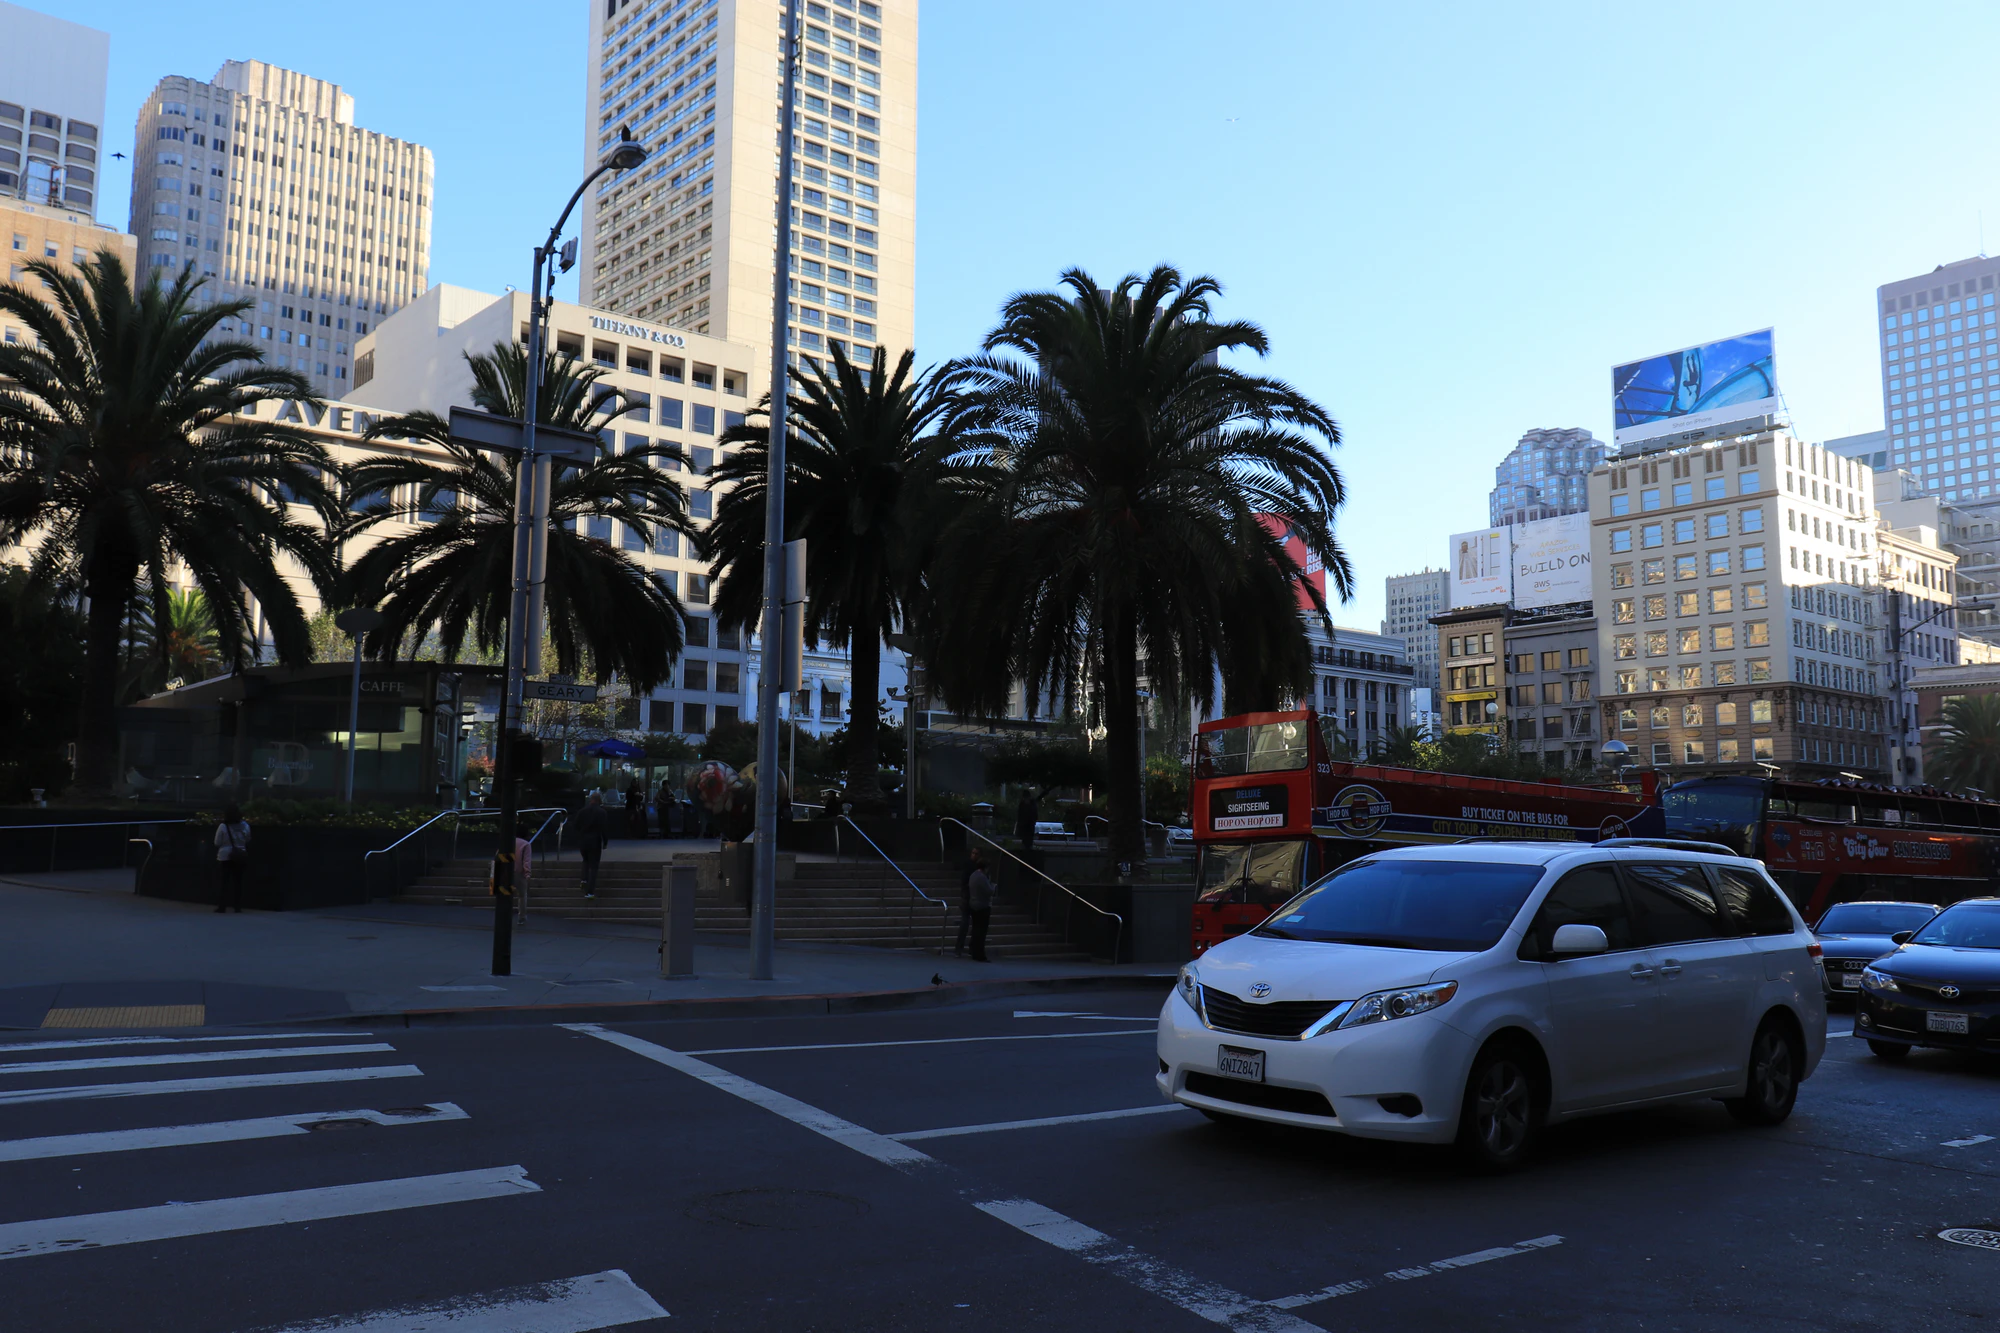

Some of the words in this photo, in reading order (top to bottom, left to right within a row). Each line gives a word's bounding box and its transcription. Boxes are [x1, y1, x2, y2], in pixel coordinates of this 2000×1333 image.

[592, 315, 651, 340] TIFFANY
[1672, 420, 1685, 429] Shot
[1694, 416, 1712, 425] iPhone
[1521, 557, 1565, 577] BUILD
[1569, 552, 1590, 567] ON
[1533, 580, 1551, 588] aws
[537, 685, 585, 698] GEARY
[1317, 763, 1331, 774] 323
[1236, 788, 1262, 799] DELUXE
[1227, 801, 1270, 813] SIGHTSEEING
[1329, 809, 1341, 819] HOP
[1341, 808, 1350, 818] ON
[1369, 804, 1380, 814] HOP
[1380, 803, 1390, 813] OFF
[1217, 819, 1234, 828] HOP
[1234, 818, 1246, 827] ON
[1247, 817, 1264, 826] HOP
[1264, 816, 1280, 825] OFF
[1462, 806, 1479, 818] BUY
[1480, 808, 1505, 821] TICKET
[1507, 810, 1520, 822] ON
[1521, 812, 1536, 824] THE
[1537, 813, 1552, 825] BUS
[1554, 814, 1569, 826] FOR
[1432, 820, 1452, 833] CITY
[1454, 822, 1479, 835] TOUR
[1487, 824, 1523, 838] GOLDEN
[1525, 828, 1545, 838] GATE
[1547, 829, 1577, 841] BRIDGE
[1843, 837, 1867, 860] City
[1868, 839, 1889, 858] Tour
[1893, 841, 1910, 858] SAN
[1910, 842, 1951, 860] FRANCISCO
[1220, 1057, 1260, 1078] 6NIZ847
